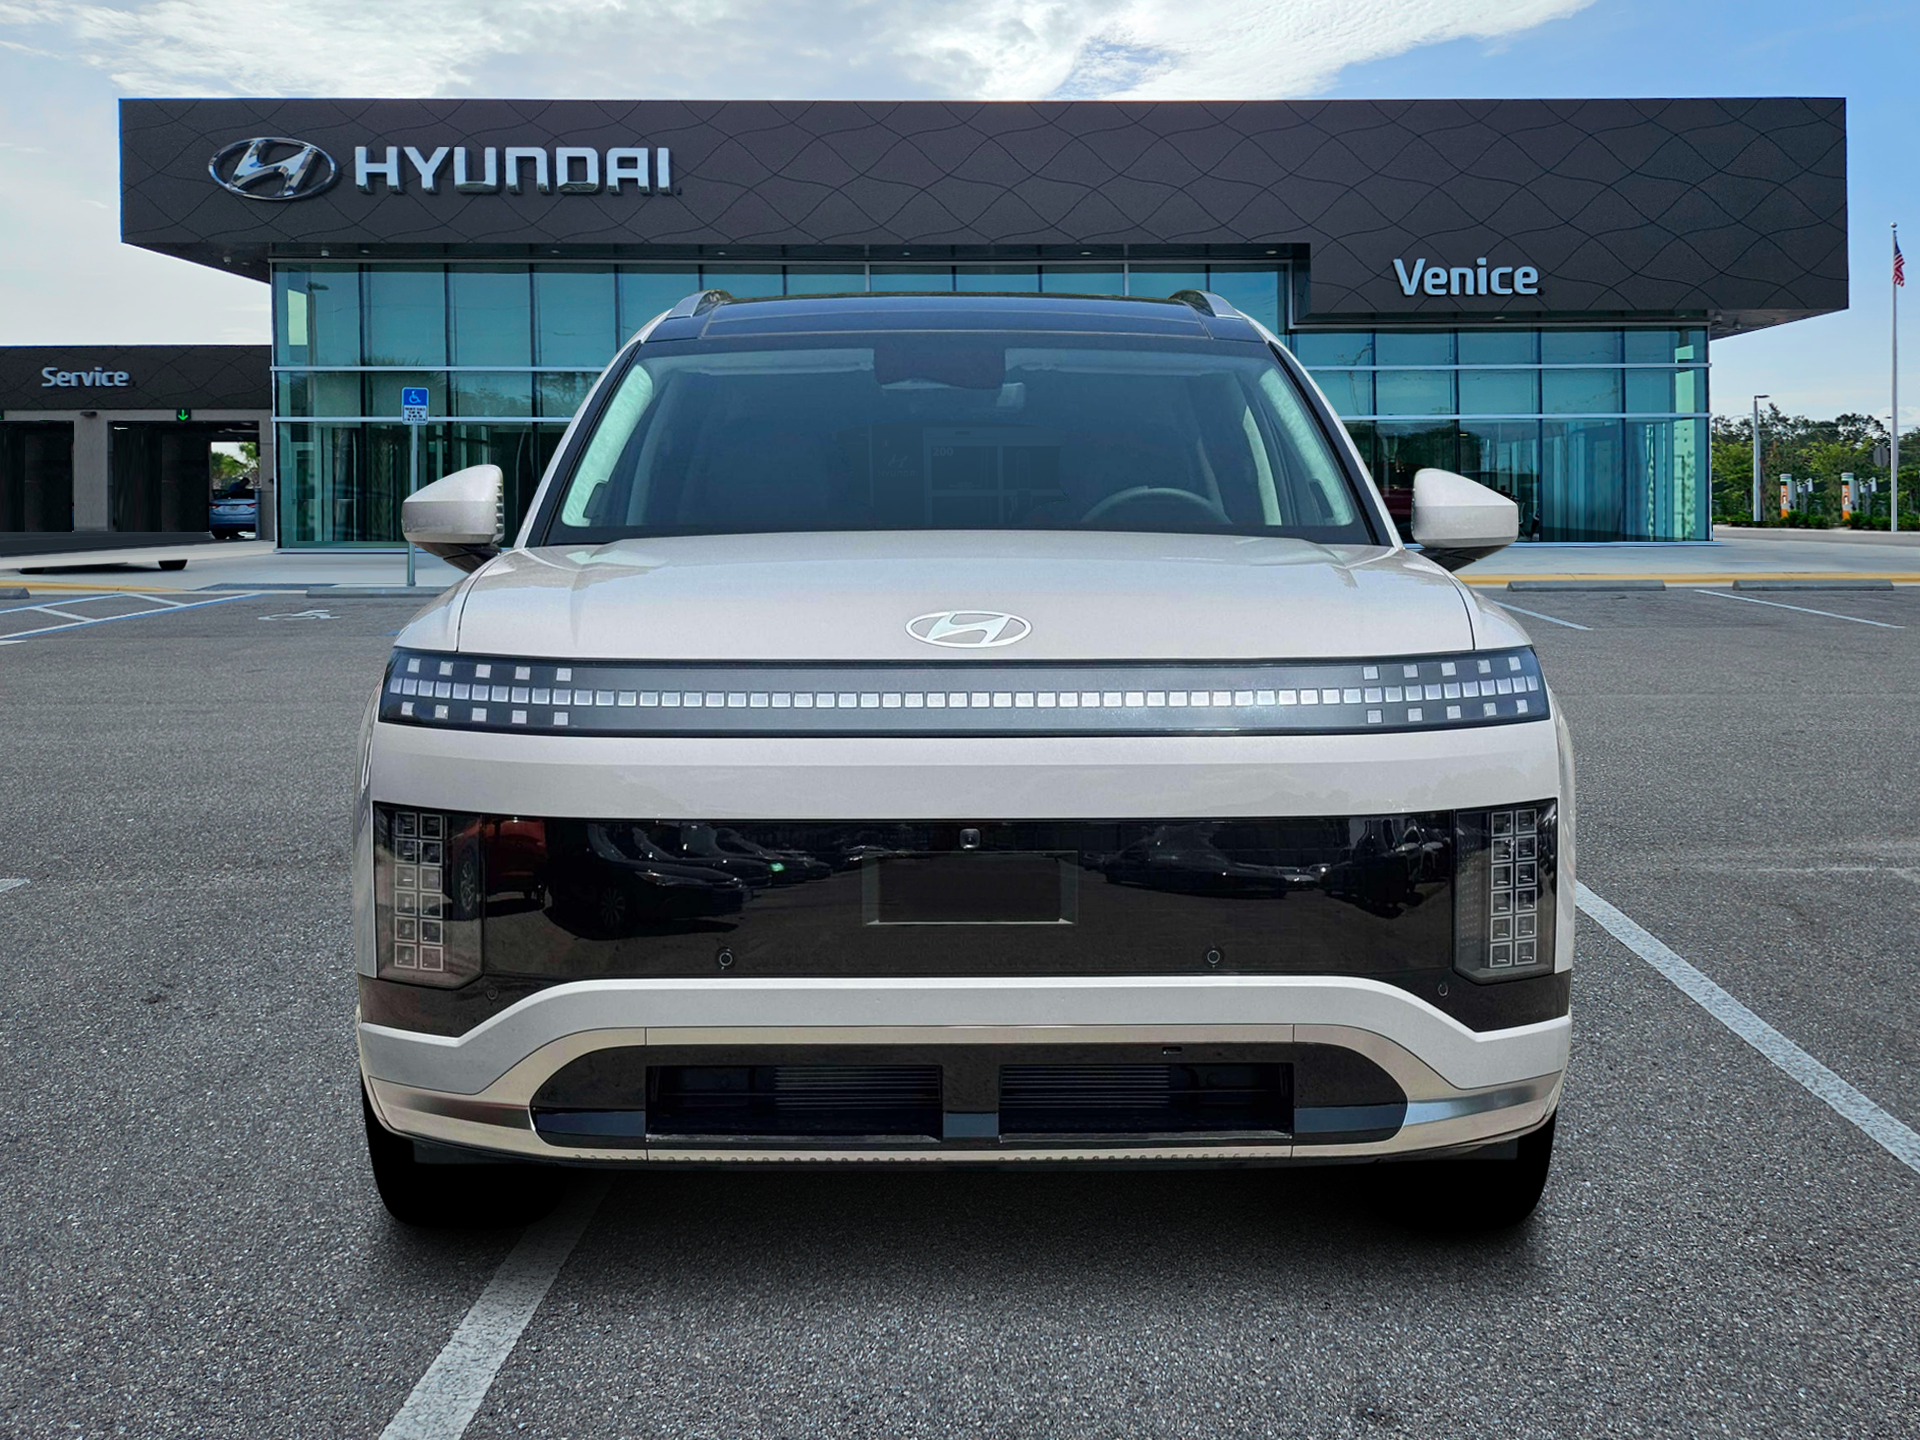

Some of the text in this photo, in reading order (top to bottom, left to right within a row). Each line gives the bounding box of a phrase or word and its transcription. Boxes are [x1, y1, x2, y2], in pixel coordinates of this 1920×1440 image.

[354, 146, 671, 194] HYUNDAI
[1392, 256, 1539, 296] Venice
[41, 366, 129, 387] Service
[932, 447, 954, 457] 200
